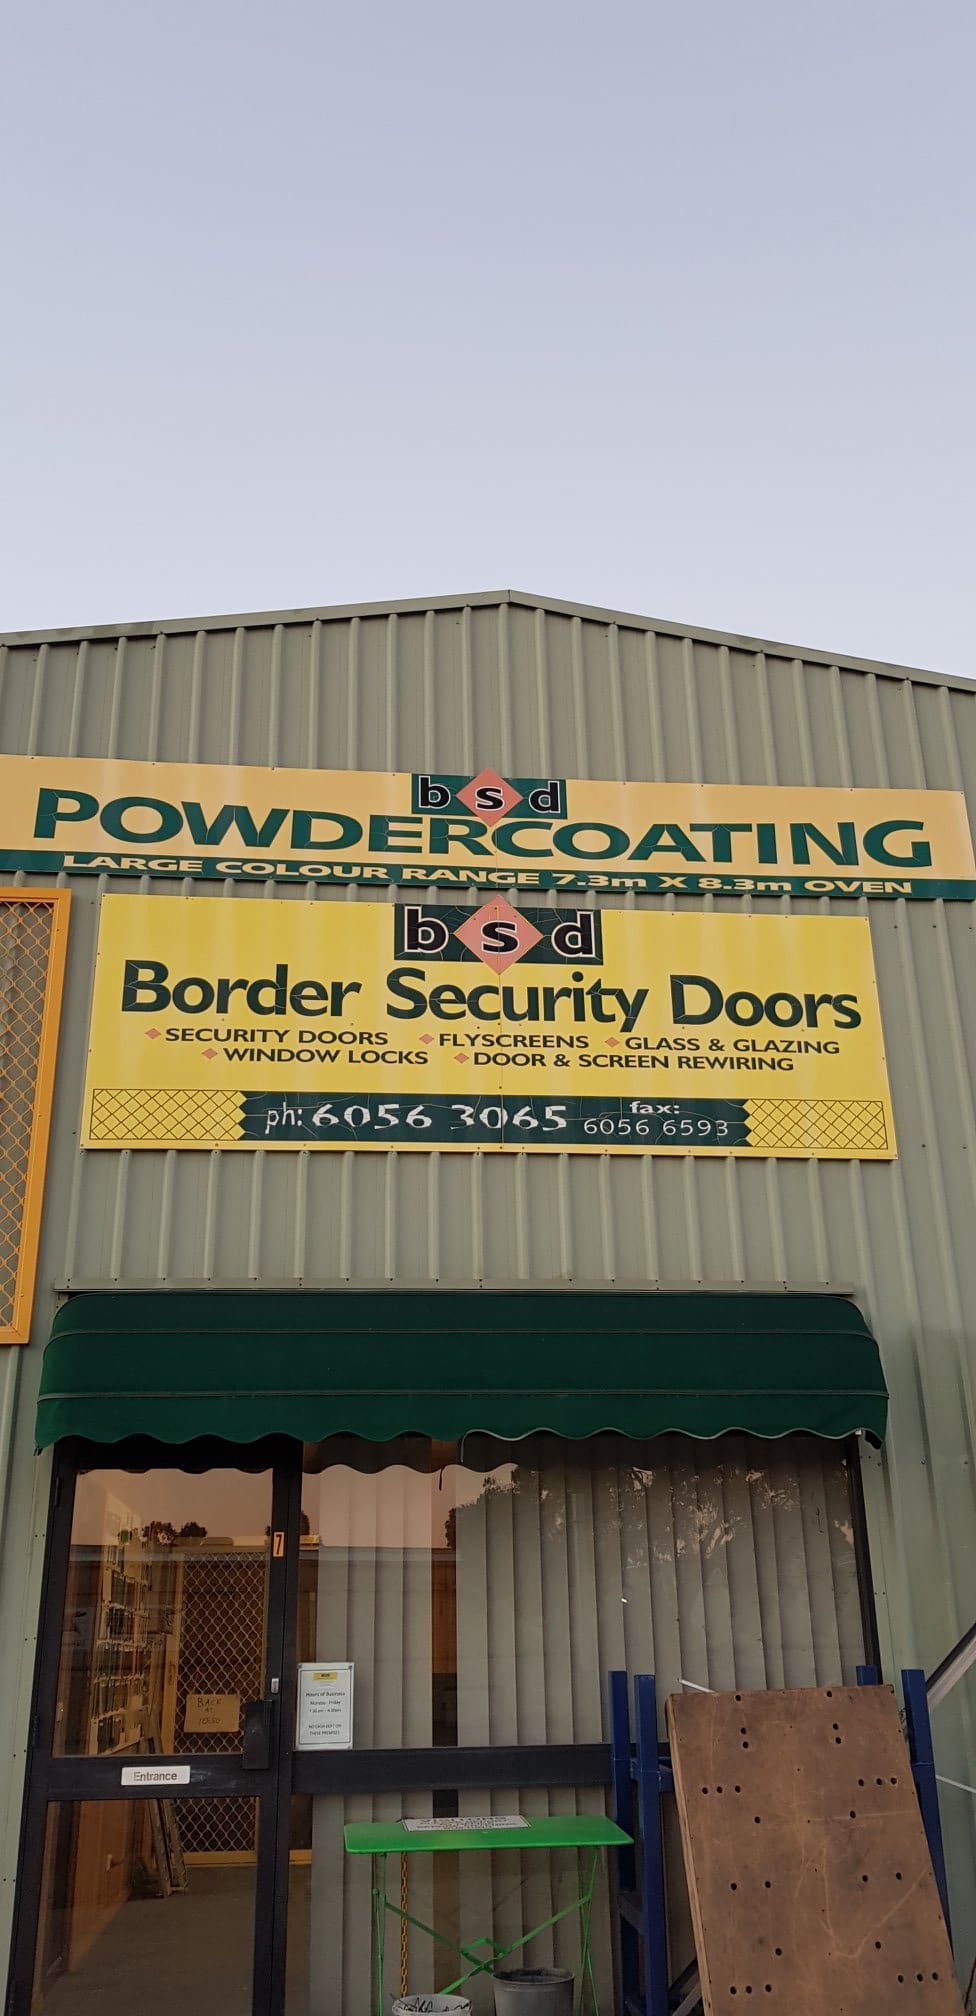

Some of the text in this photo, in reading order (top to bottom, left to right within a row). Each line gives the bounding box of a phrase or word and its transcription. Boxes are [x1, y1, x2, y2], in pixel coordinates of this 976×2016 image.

[34, 787, 933, 868] POWDERCOATING
[63, 854, 912, 894] LARGE COLOUR RANGE 7.3m X 8.3m OVEN
[121, 959, 862, 1033] Border Security Doors
[165, 1027, 389, 1046] SECURITY DOORS
[439, 1033, 589, 1049] FLYSCREENS
[625, 1036, 841, 1055] GLASS & GLAZING
[223, 1047, 429, 1066] WINDOW LOCKS
[473, 1051, 795, 1072] DOOR & SCREEN REWIRING
[265, 1101, 568, 1135] ph: 6056 3065
[629, 1101, 680, 1116] fax:
[583, 1118, 729, 1137] 6056 6593
[276, 1533, 283, 1556] 7
[133, 1771, 178, 1782] Entrance
